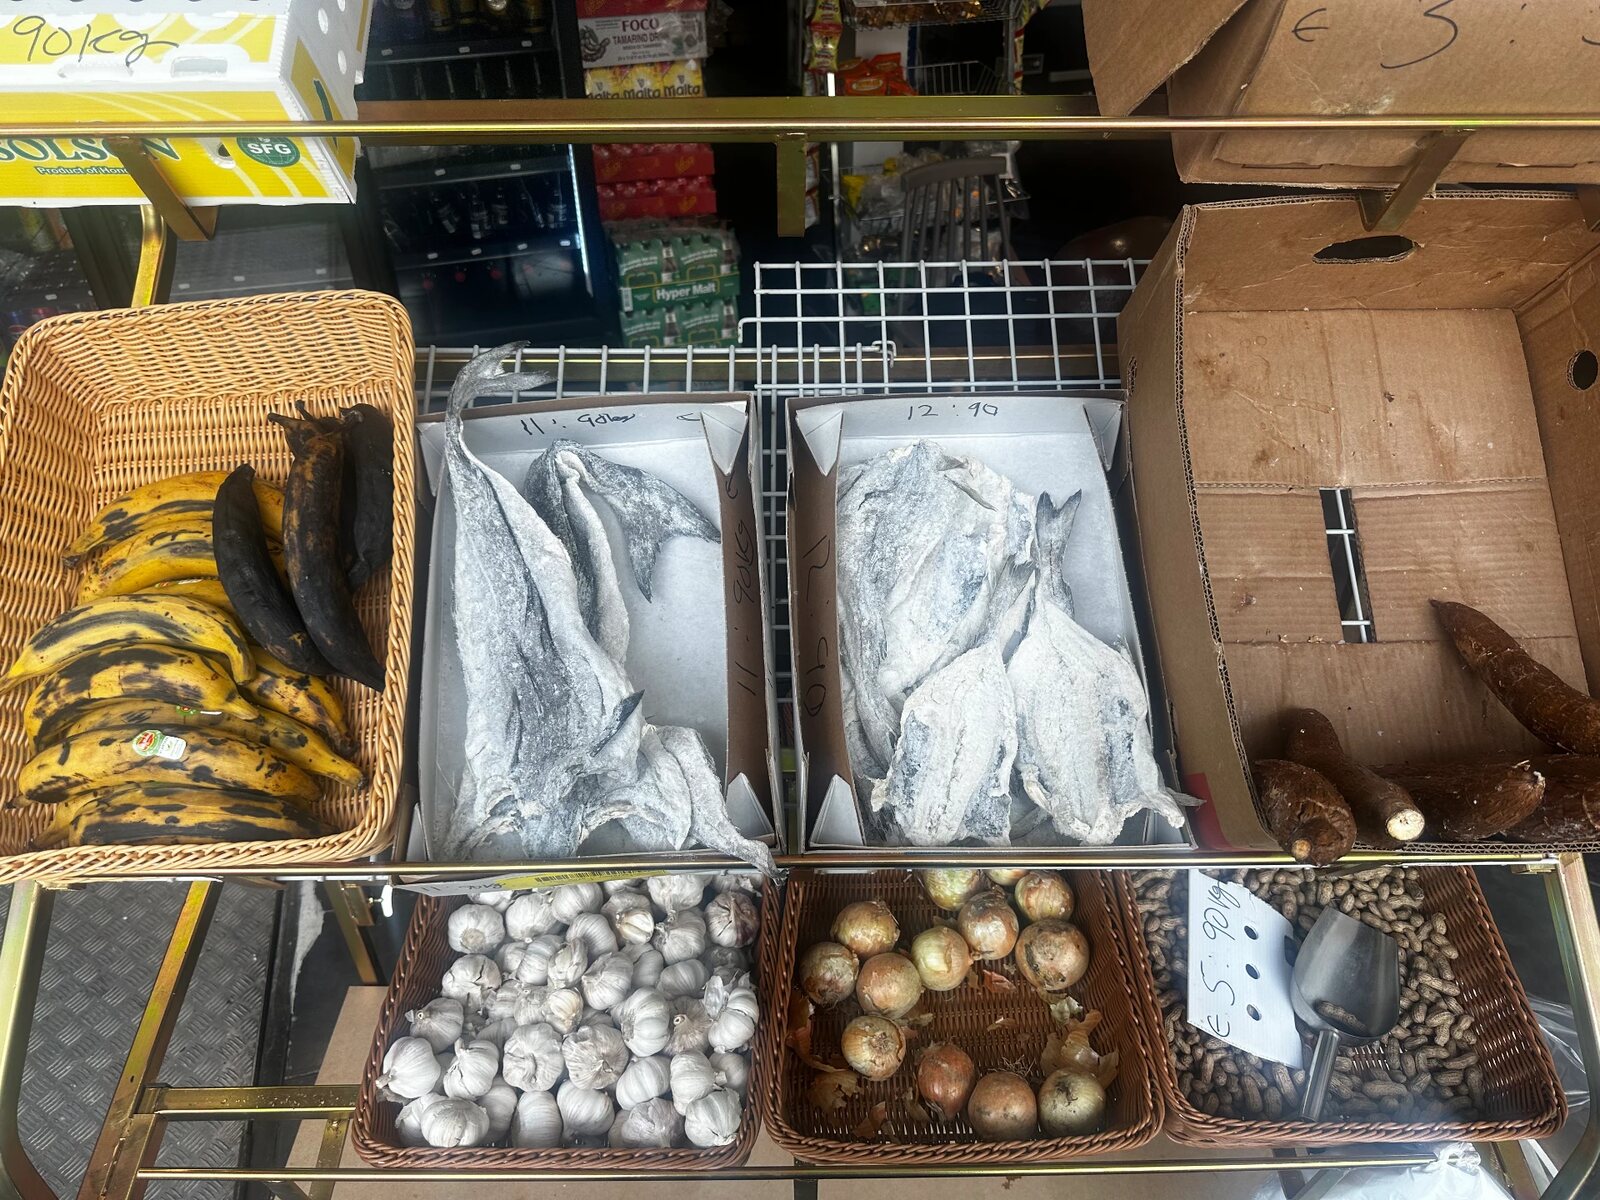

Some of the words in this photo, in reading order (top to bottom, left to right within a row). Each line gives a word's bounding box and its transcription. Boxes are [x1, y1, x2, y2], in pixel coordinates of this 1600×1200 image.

[621, 18, 660, 33] FOCO
[612, 33, 649, 46] TAMARIND
[247, 143, 292, 155] SFG
[37, 166, 84, 175] Product
[86, 166, 99, 174] of
[656, 287, 690, 301] Hyper
[692, 282, 717, 294] Malt
